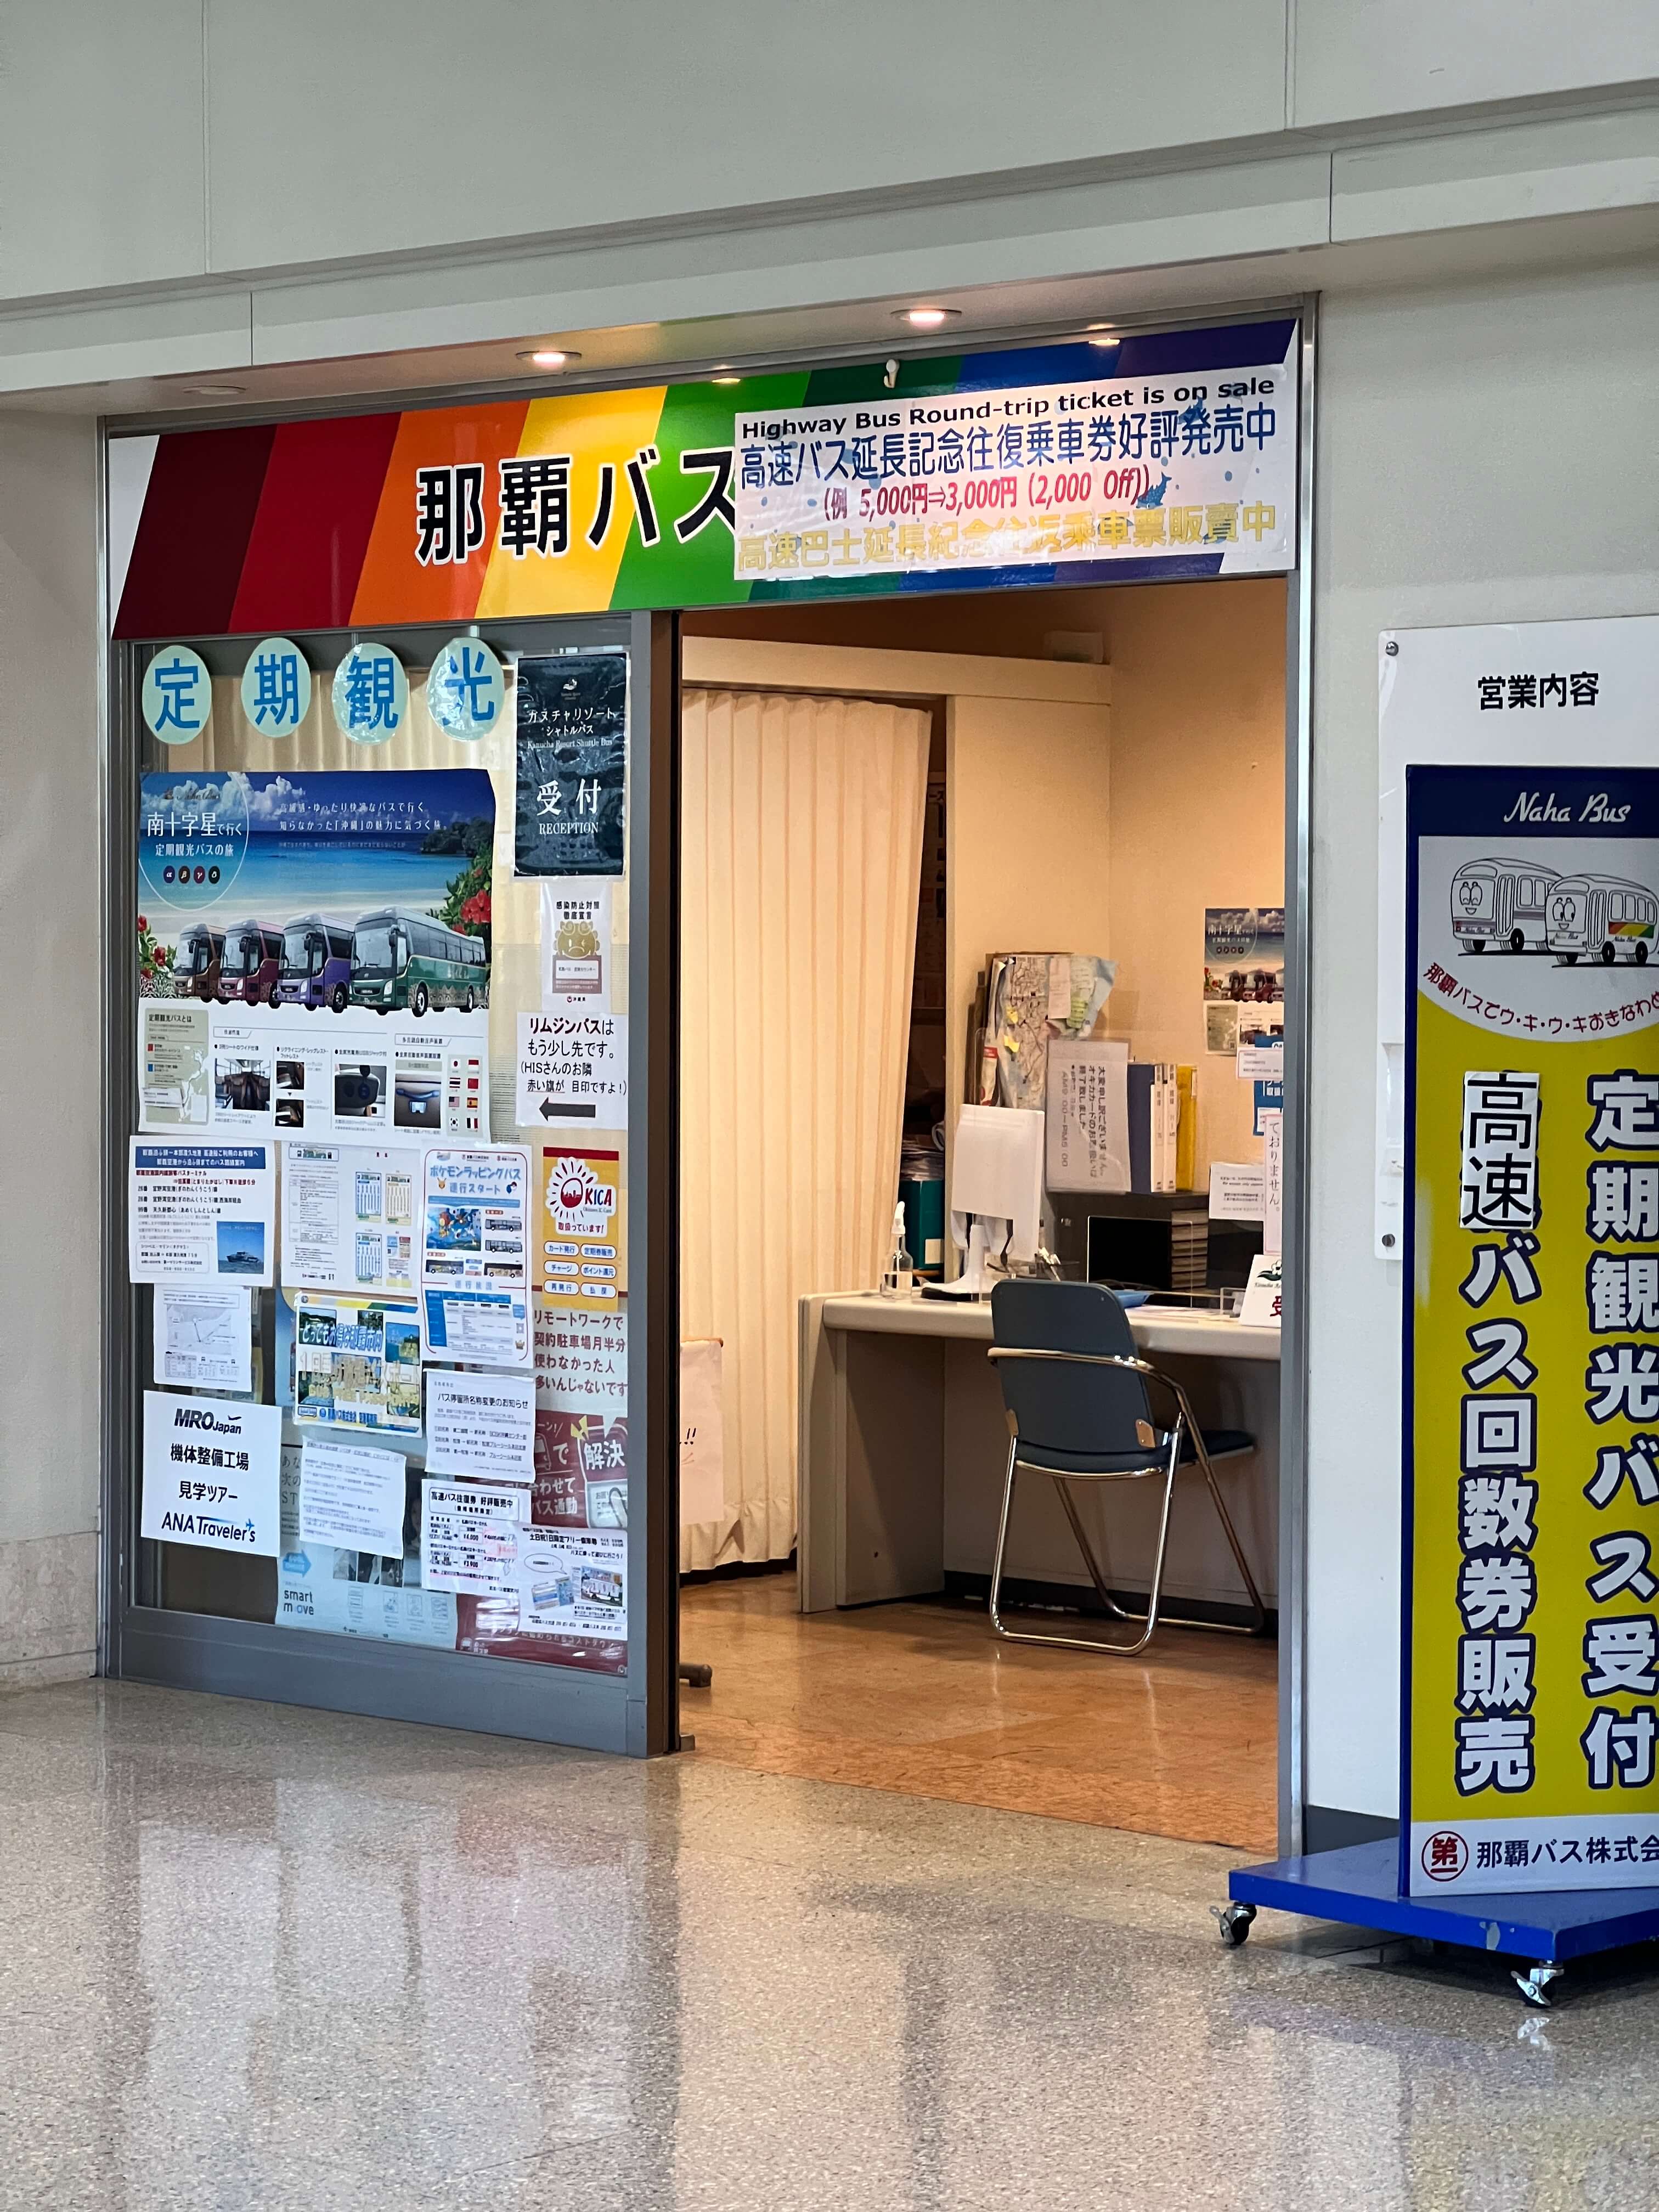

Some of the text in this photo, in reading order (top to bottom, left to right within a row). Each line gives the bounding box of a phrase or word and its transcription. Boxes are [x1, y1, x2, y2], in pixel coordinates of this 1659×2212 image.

[742, 377, 1274, 439] Highway Bus Round-trip ticket is on sale
[740, 402, 1276, 490] 高速バス延長記念往復乗車券好評発売中
[416, 447, 735, 563] 那覇バス
[1477, 670, 1600, 712] 営業内容
[545, 724, 594, 737] シャトルバス
[536, 778, 602, 816] 受付
[1504, 792, 1632, 825] Naha Bus
[147, 811, 241, 838] 南十字星で行く
[539, 821, 599, 835] RECEPTION
[155, 843, 234, 857] 定期観光バスの旅
[530, 1017, 614, 1036] リムジンバスは
[528, 1038, 614, 1059] もう少し先です。
[527, 1079, 565, 1093] 赤い旗が
[430, 1165, 522, 1181] ポケモンラッピングバス
[449, 1182, 501, 1195] 運行スタート
[548, 1245, 575, 1254] カード発行
[583, 1266, 614, 1277] ポイント還元
[534, 1310, 624, 1331] リモートワークで
[534, 1331, 626, 1353] 契約駐車場月半分
[534, 1353, 616, 1374] 使わなかった人
[535, 1374, 628, 1397] 多いんじゃないです
[173, 1408, 242, 1435] MRO Japan
[1457, 1071, 1541, 1794] 高速バス回数券販売
[1582, 1071, 1659, 1788] 定期観光バス受付
[170, 1443, 250, 1471] 機体整備工場
[583, 1438, 626, 1471] 解決
[178, 1480, 238, 1503] 見学ツアー
[161, 1511, 195, 1534] ANA
[196, 1515, 256, 1543] Traveler's
[283, 1589, 313, 1604] smart
[283, 1601, 314, 1616] move
[1476, 1833, 1659, 1870] 那覇バス株式会
